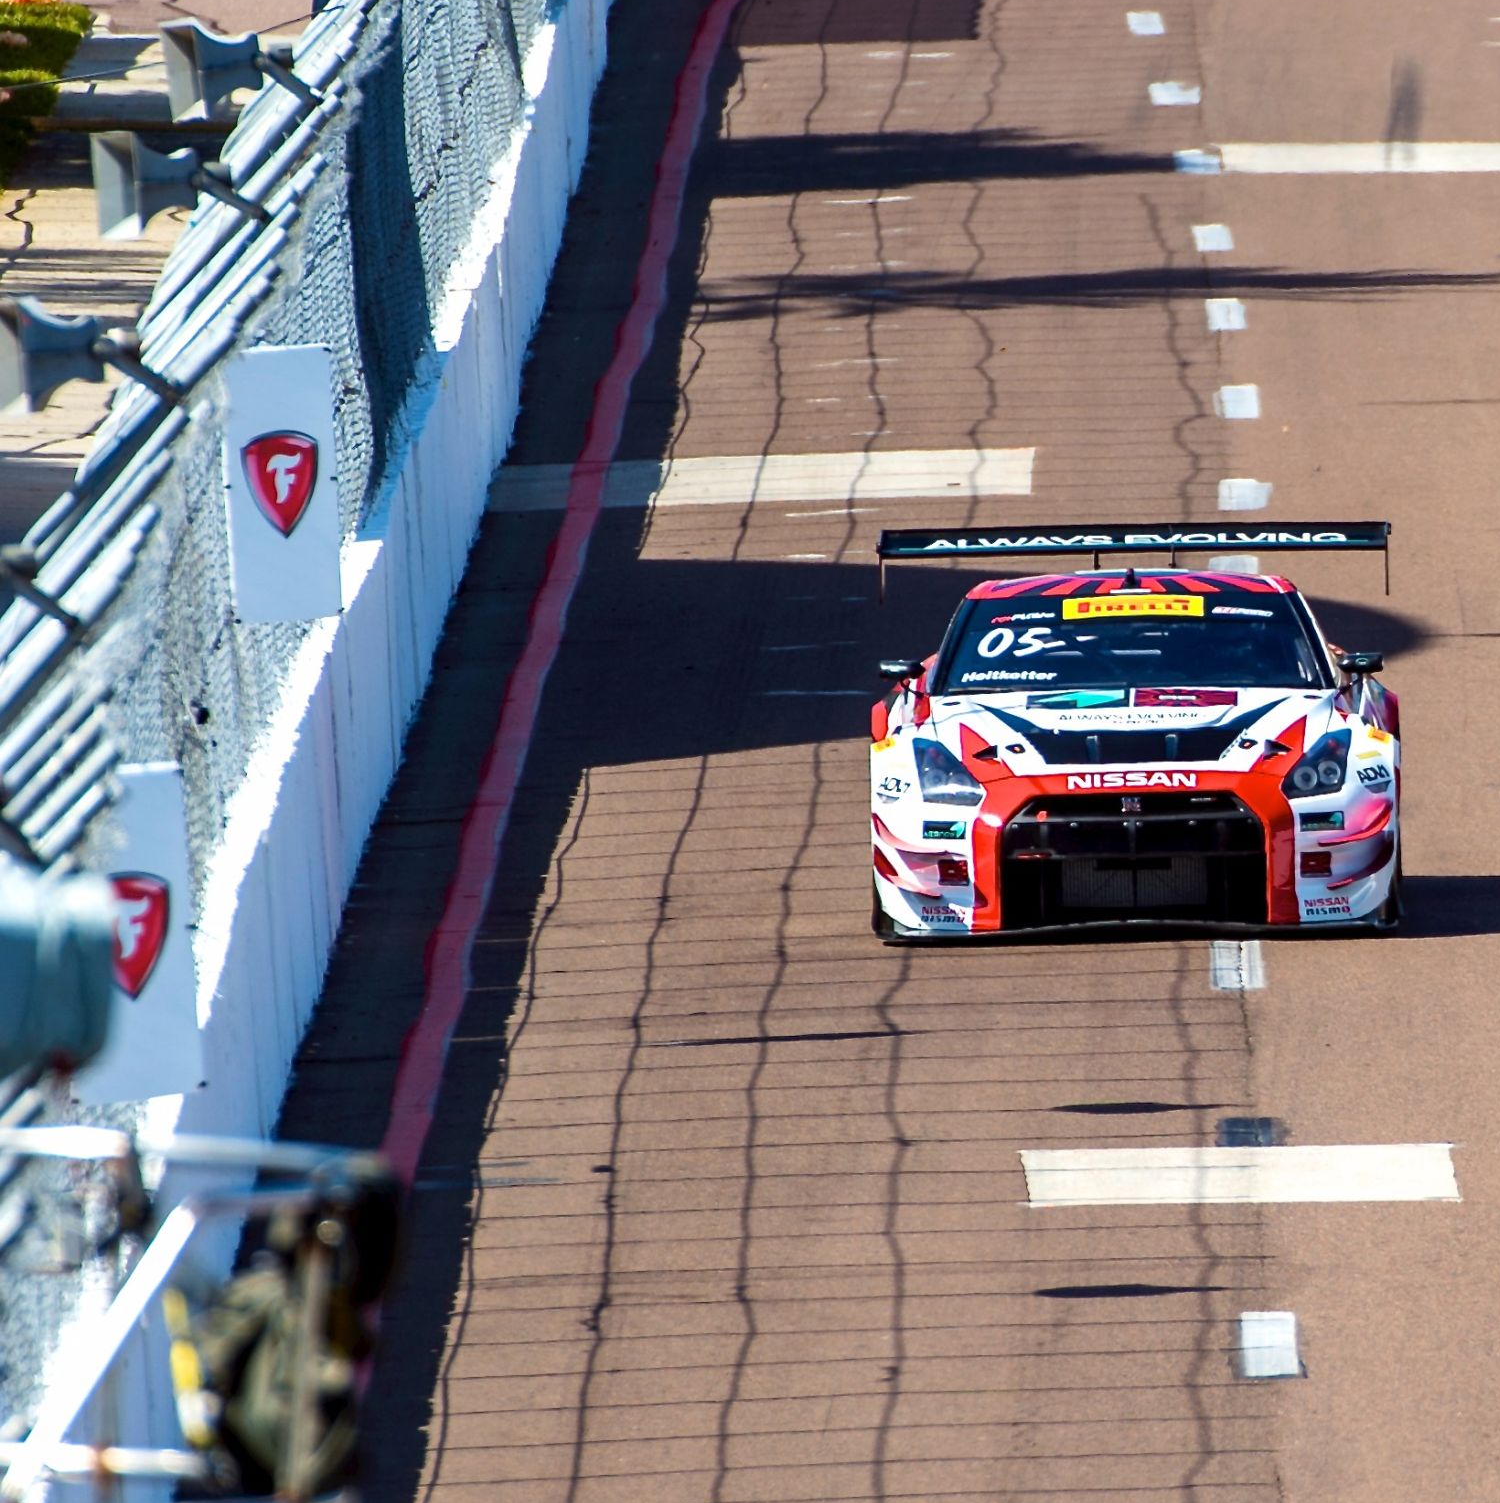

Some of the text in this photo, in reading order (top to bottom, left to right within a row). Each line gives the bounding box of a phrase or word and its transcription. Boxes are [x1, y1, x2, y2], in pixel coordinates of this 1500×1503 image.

[265, 451, 302, 504] F
[922, 531, 1347, 550] ALWAYS EVOLVING
[1077, 598, 1191, 614] PIRELLI
[1067, 771, 1198, 791] NISSAN
[1303, 896, 1350, 907] NISSAN
